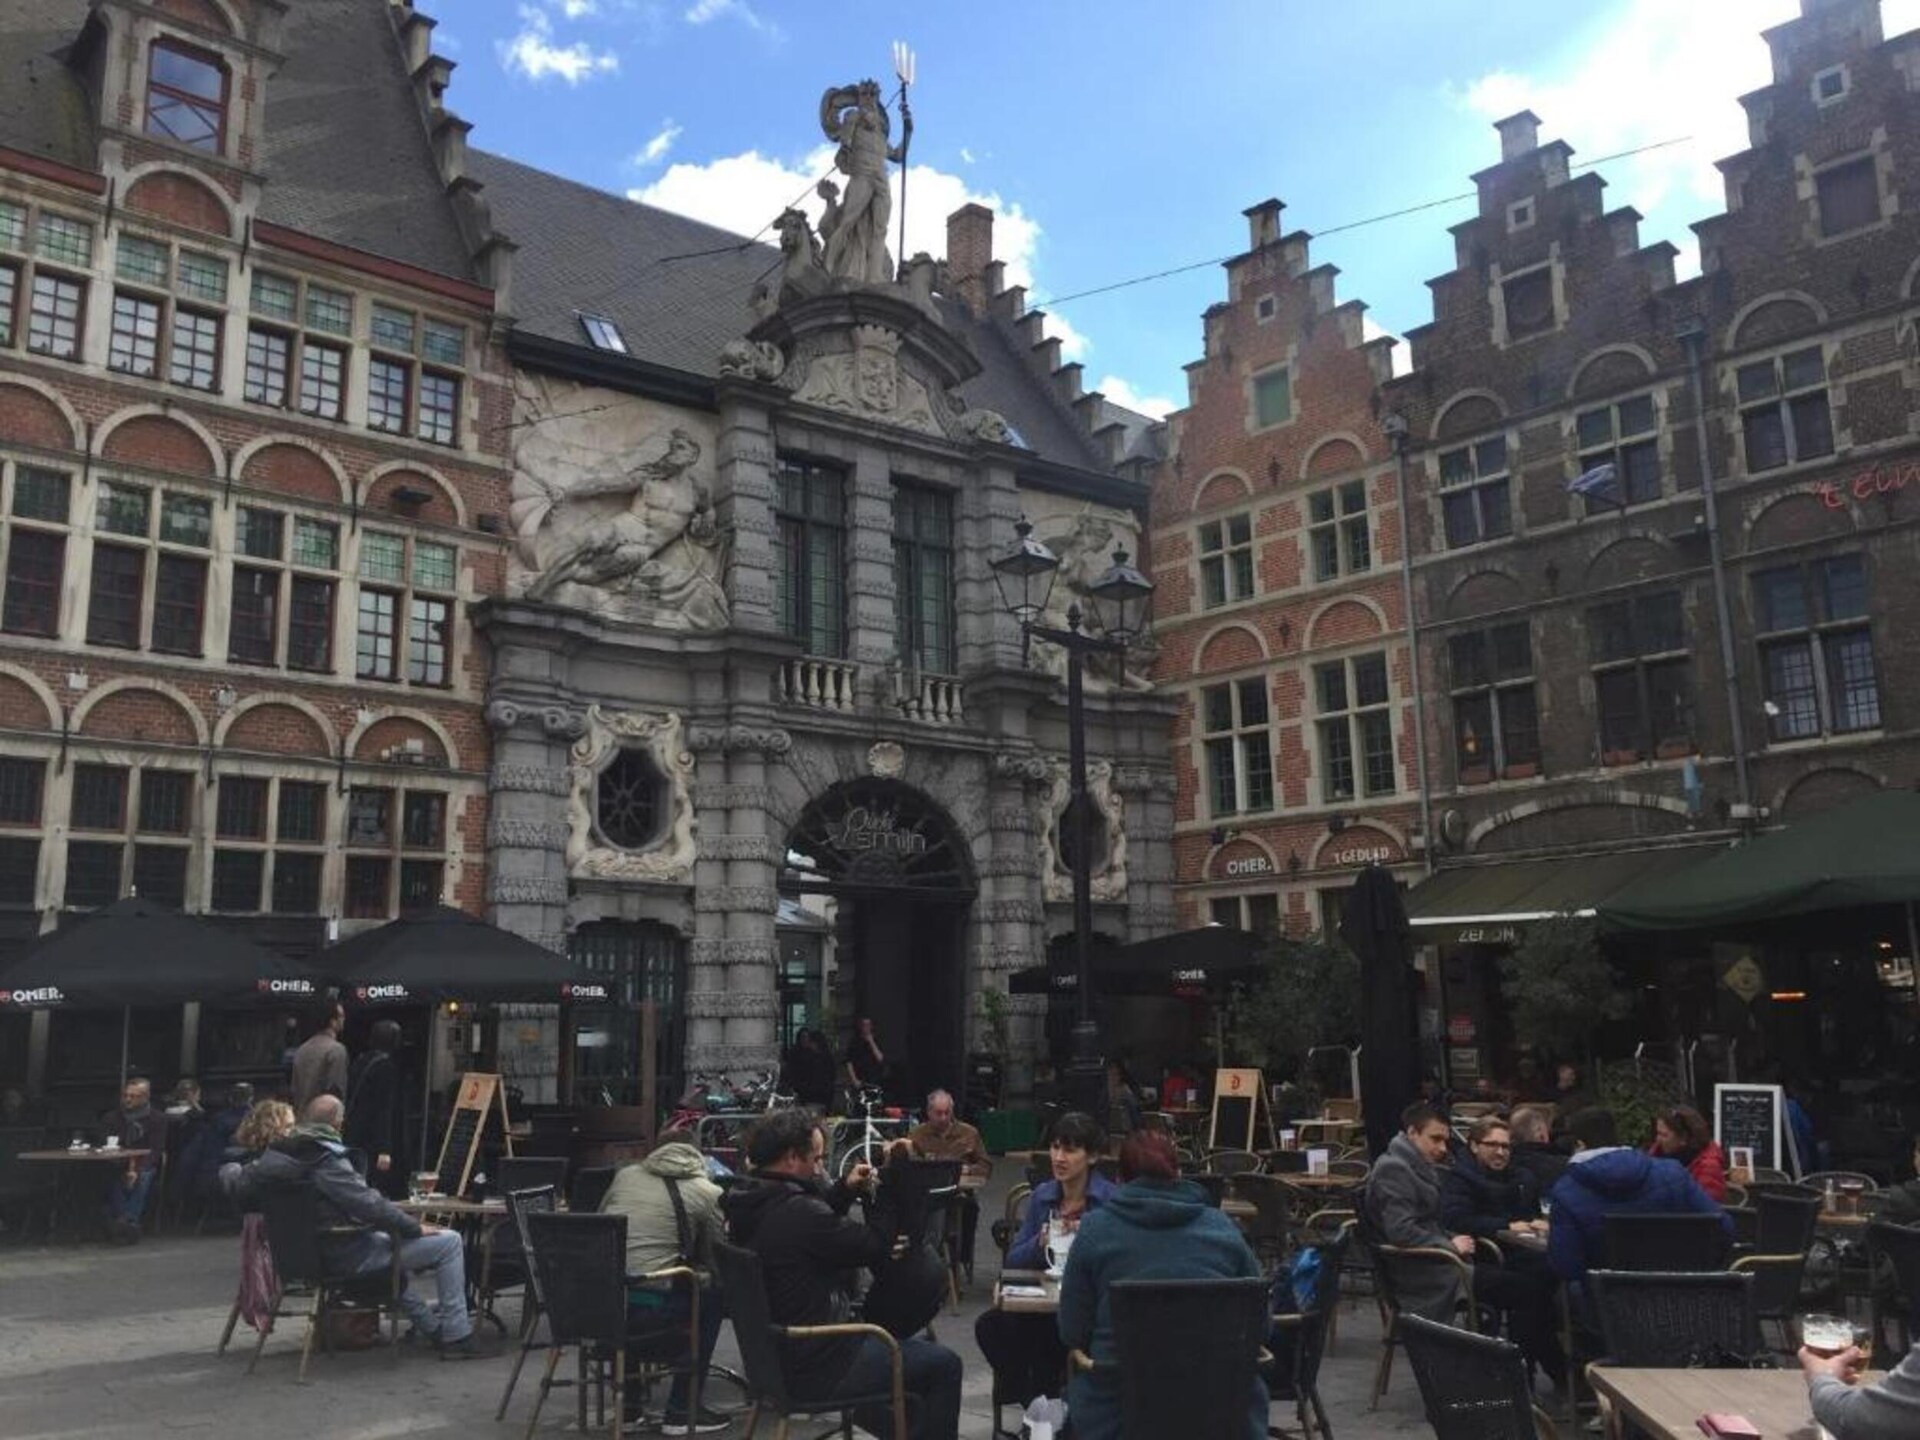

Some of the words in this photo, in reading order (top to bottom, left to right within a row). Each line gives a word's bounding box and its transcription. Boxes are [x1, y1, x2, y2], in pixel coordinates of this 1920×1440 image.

[270, 980, 315, 993] OMER.
[367, 986, 409, 998] OMER.
[12, 987, 64, 1002] OMER.
